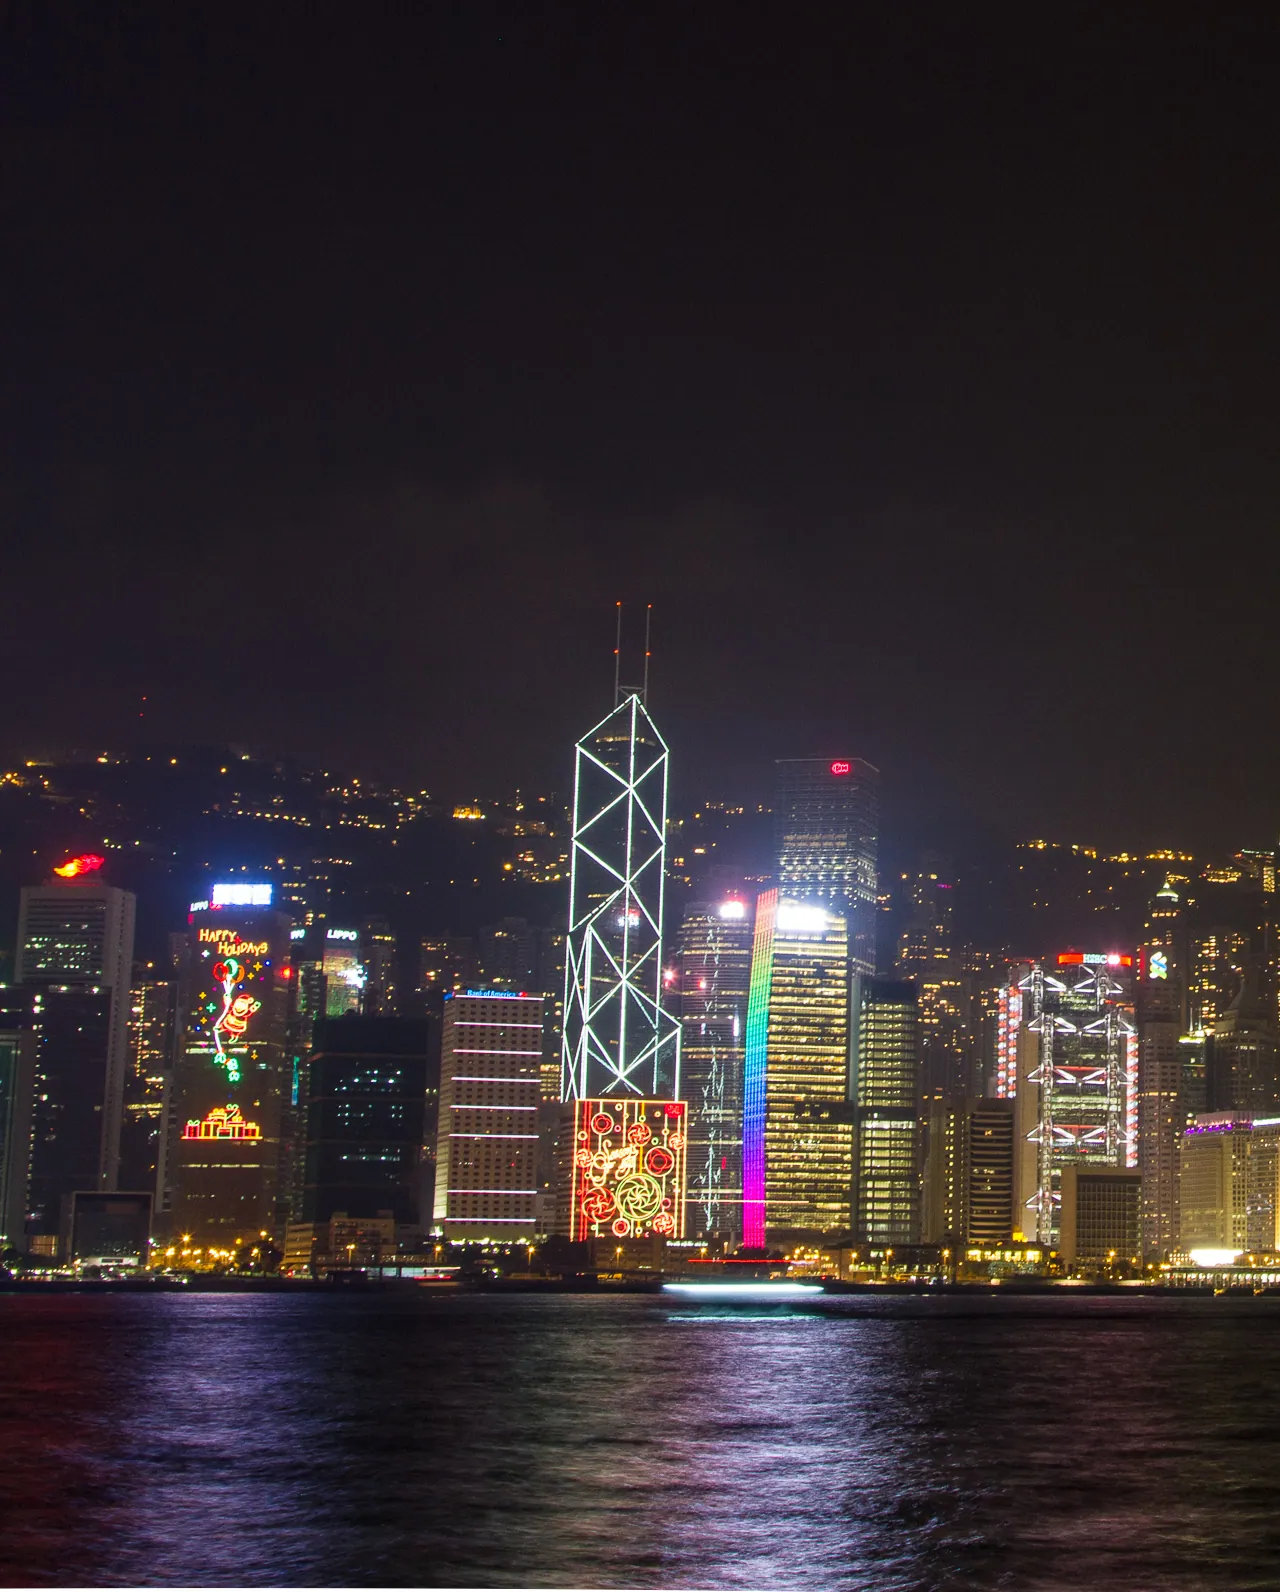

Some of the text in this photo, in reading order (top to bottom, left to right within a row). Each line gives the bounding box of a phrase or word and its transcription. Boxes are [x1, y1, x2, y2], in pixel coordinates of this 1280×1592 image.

[190, 900, 209, 912] LIPPO
[199, 929, 237, 942] HAPPY
[327, 929, 357, 941] LIPPO
[218, 941, 268, 957] HOLIDAYS
[467, 989, 482, 997] Bank
[491, 990, 516, 998] America
